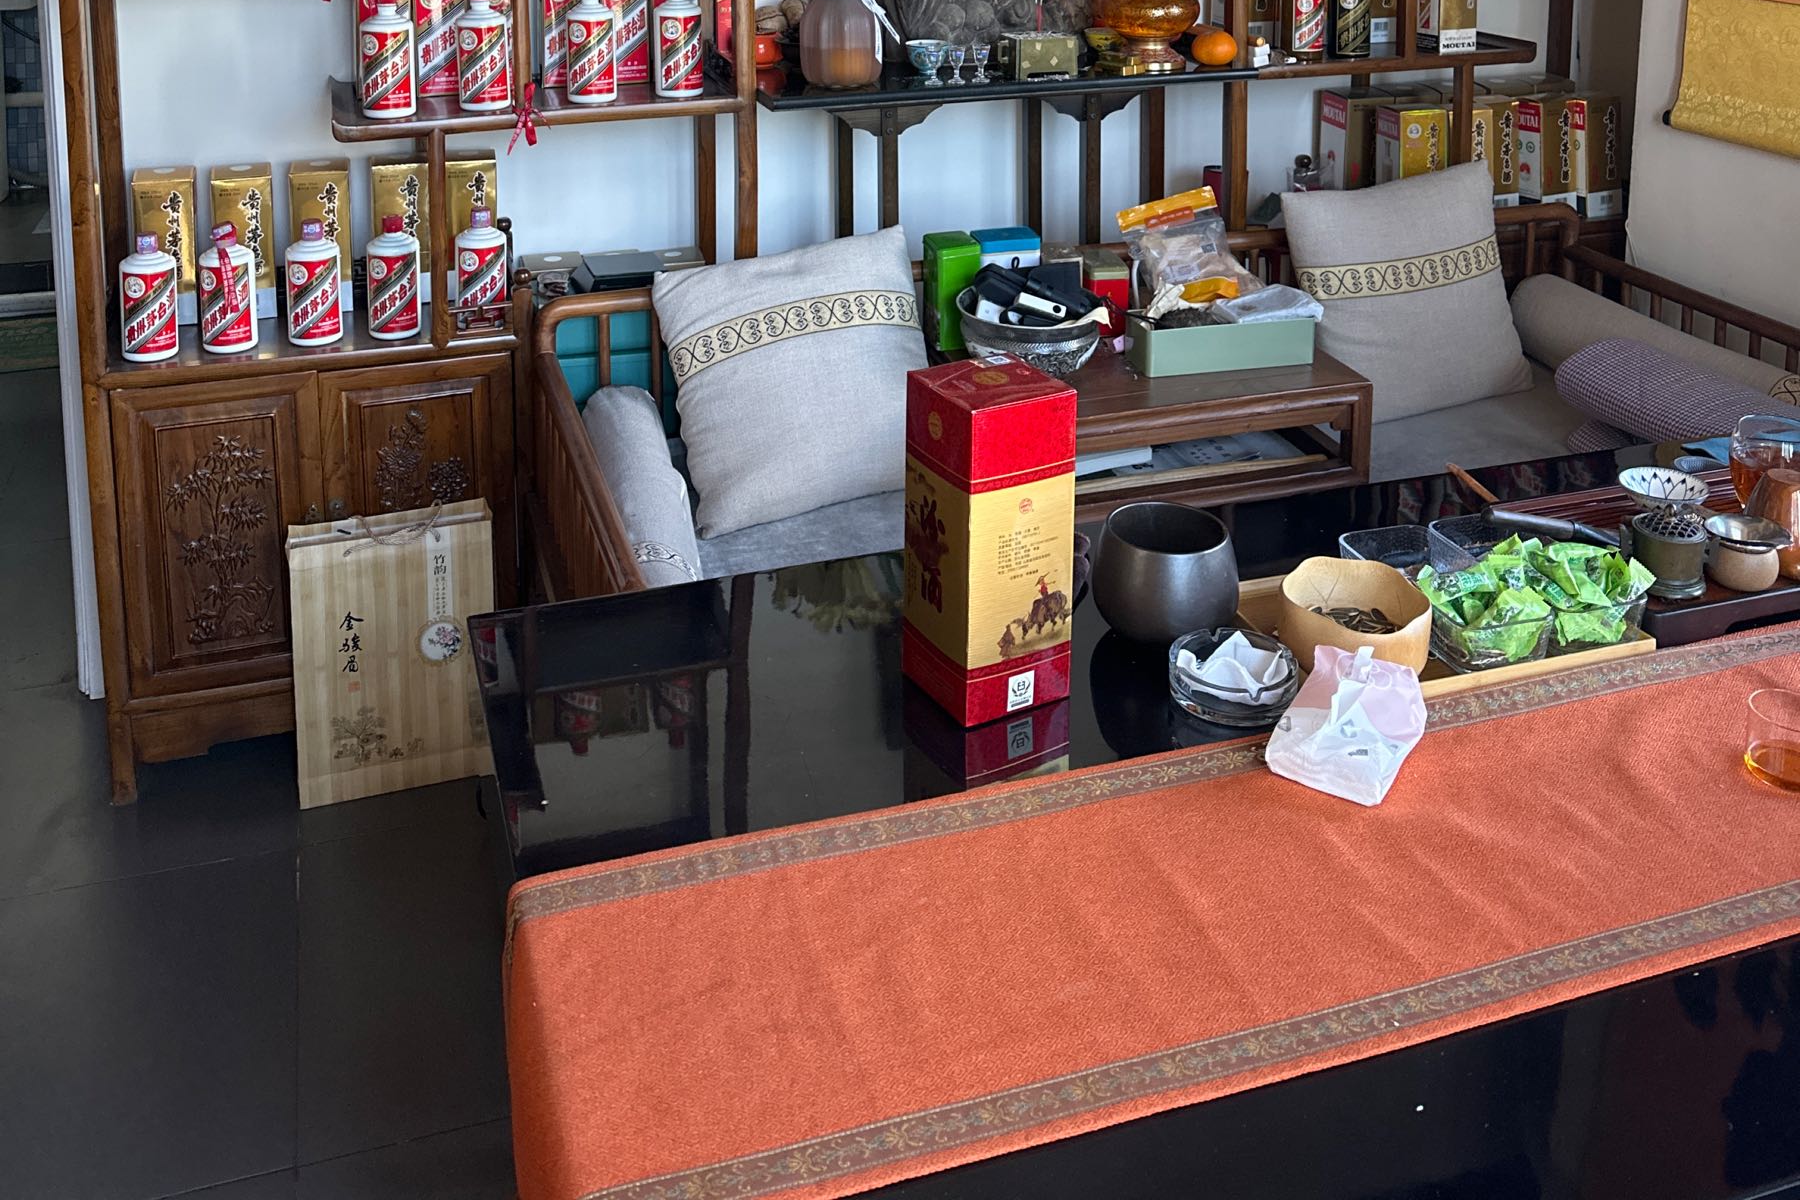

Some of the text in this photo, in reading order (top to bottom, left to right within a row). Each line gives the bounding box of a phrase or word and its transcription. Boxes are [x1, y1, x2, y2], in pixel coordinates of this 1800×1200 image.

[363, 47, 409, 100] 贵州茅台酒
[1442, 41, 1476, 50] MOUTAI
[1322, 104, 1346, 124] MOUTAI
[1499, 110, 1514, 184] 贵州茅台酒
[126, 284, 175, 345] 贵州茅台酒
[292, 271, 338, 330] 贵州茅台酒
